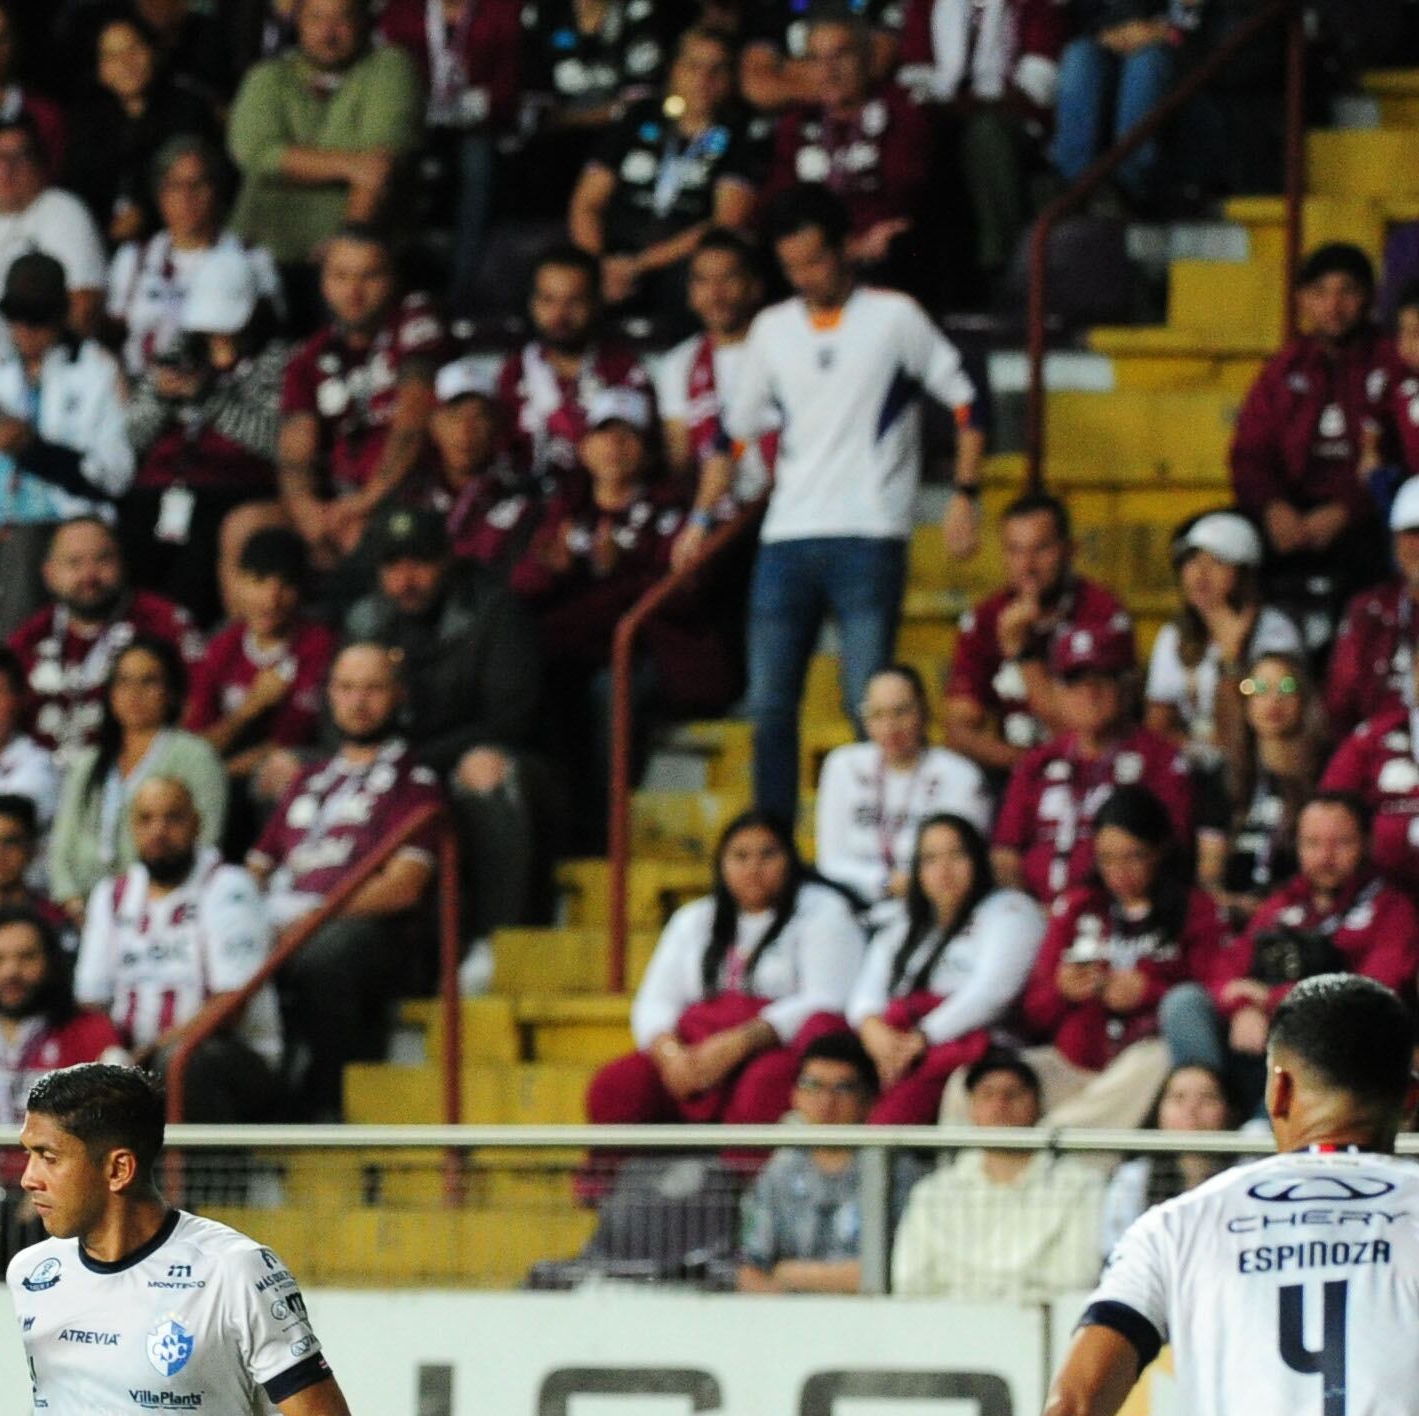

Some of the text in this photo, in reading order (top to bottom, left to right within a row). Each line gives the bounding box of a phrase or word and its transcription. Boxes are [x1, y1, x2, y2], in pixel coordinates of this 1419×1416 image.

[1227, 1209, 1411, 1234] CHERY
[1238, 1239, 1392, 1274] ESPINOZA
[147, 1280, 206, 1290] MONTECO
[58, 1328, 120, 1346] ATREVIA
[129, 1389, 205, 1406] VillaPlants
